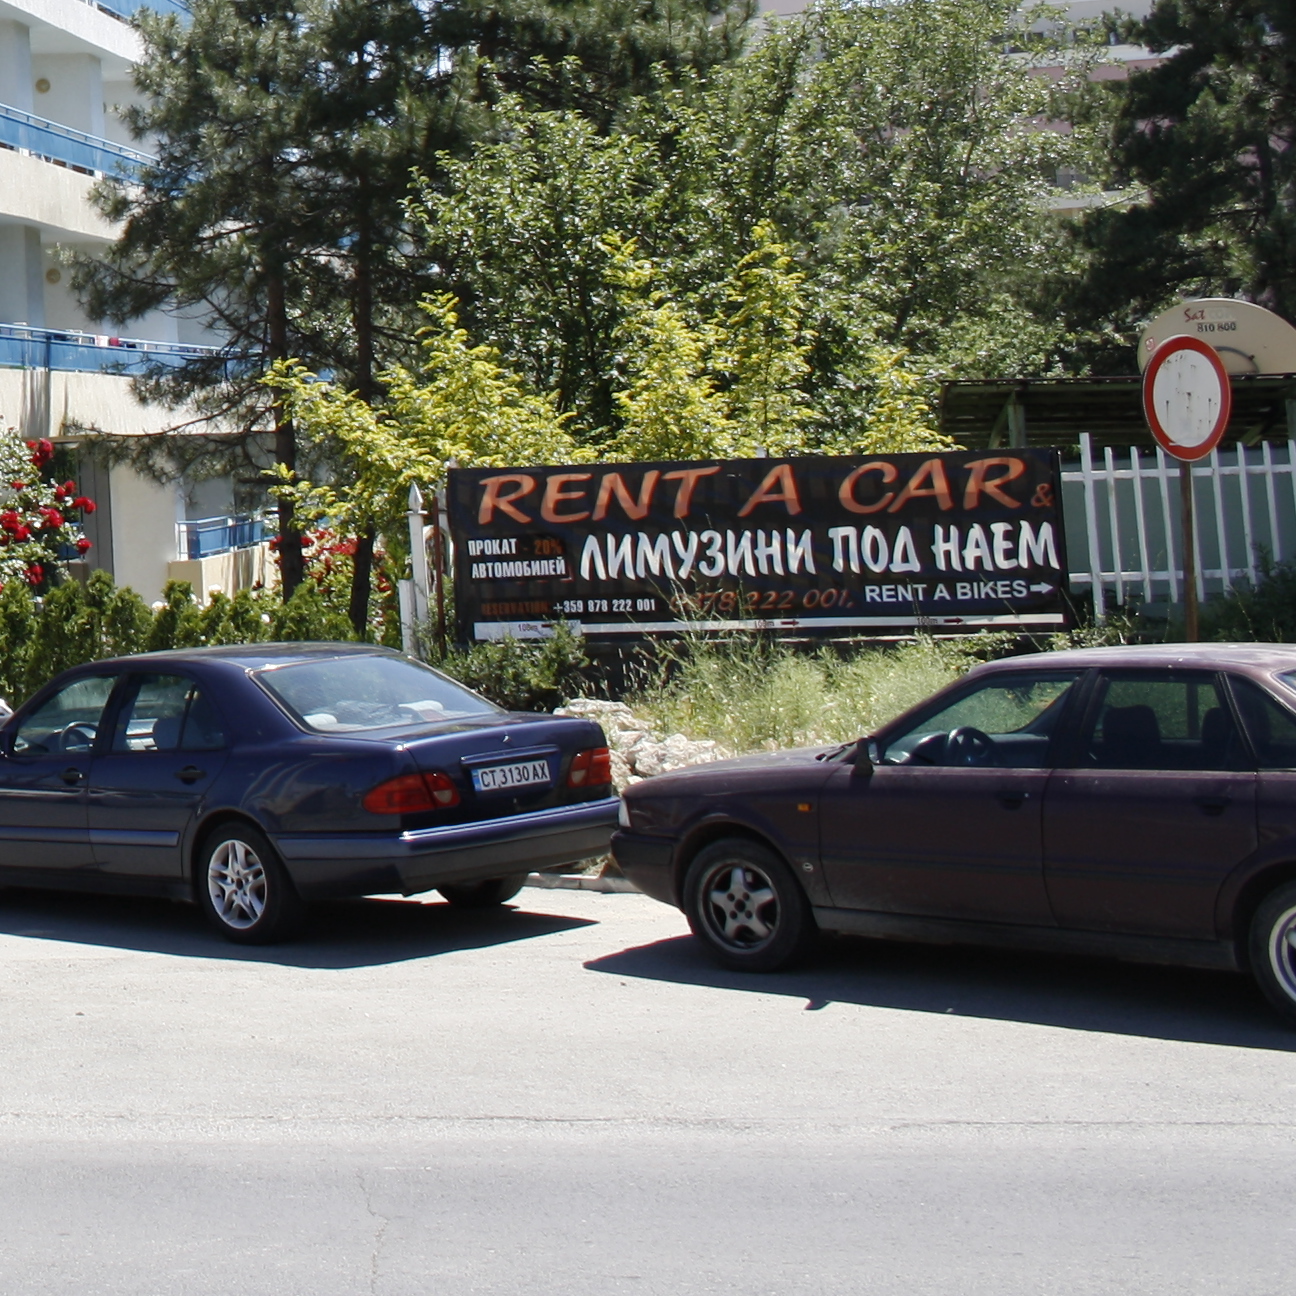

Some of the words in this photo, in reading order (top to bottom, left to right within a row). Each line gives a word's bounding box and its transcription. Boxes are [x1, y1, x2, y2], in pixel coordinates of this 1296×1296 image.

[477, 466, 721, 525] RENT
[736, 463, 802, 517] A
[838, 457, 1027, 515] CAR
[468, 538, 517, 556] ПРОКАТ
[580, 527, 817, 581] ЛИМУЗИНИ
[828, 524, 921, 574] ПОД
[930, 519, 1061, 573] НАЕМ
[471, 556, 567, 579] АВТОМОБИЛЕЙ
[865, 584, 928, 603] RENT
[933, 582, 951, 601] A
[956, 579, 1029, 600] BIKES
[588, 599, 608, 613] 878
[612, 598, 633, 612] 222
[636, 598, 656, 612] 001
[499, 765, 530, 786] 3130
